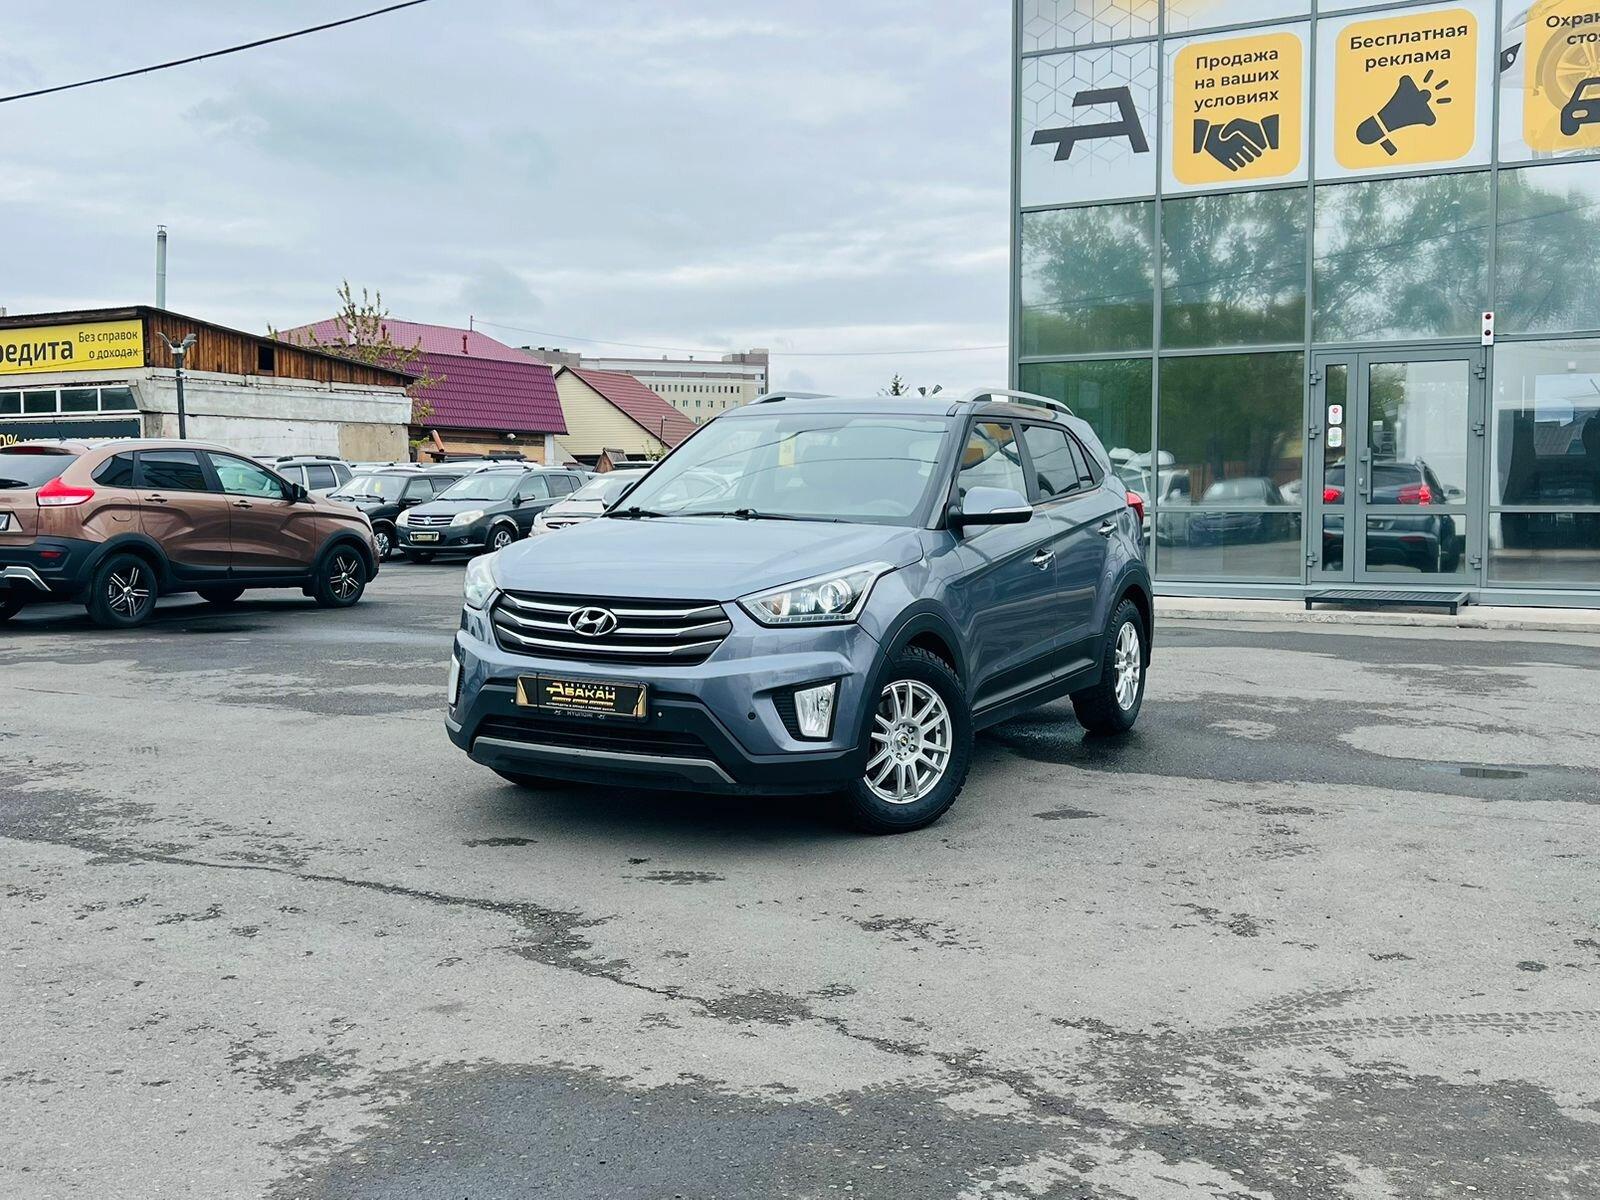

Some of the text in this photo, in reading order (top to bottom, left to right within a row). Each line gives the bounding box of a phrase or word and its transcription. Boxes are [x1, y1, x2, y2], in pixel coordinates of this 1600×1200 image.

[1350, 24, 1468, 50] Бесплатная
[1566, 33, 1600, 45] сто
[1196, 49, 1279, 71] Продажа
[1365, 47, 1451, 72] реклама
[1194, 69, 1280, 90] на ваших
[1194, 89, 1280, 113] условиях
[79, 331, 138, 343] Без справок
[89, 348, 138, 360] о доходах
